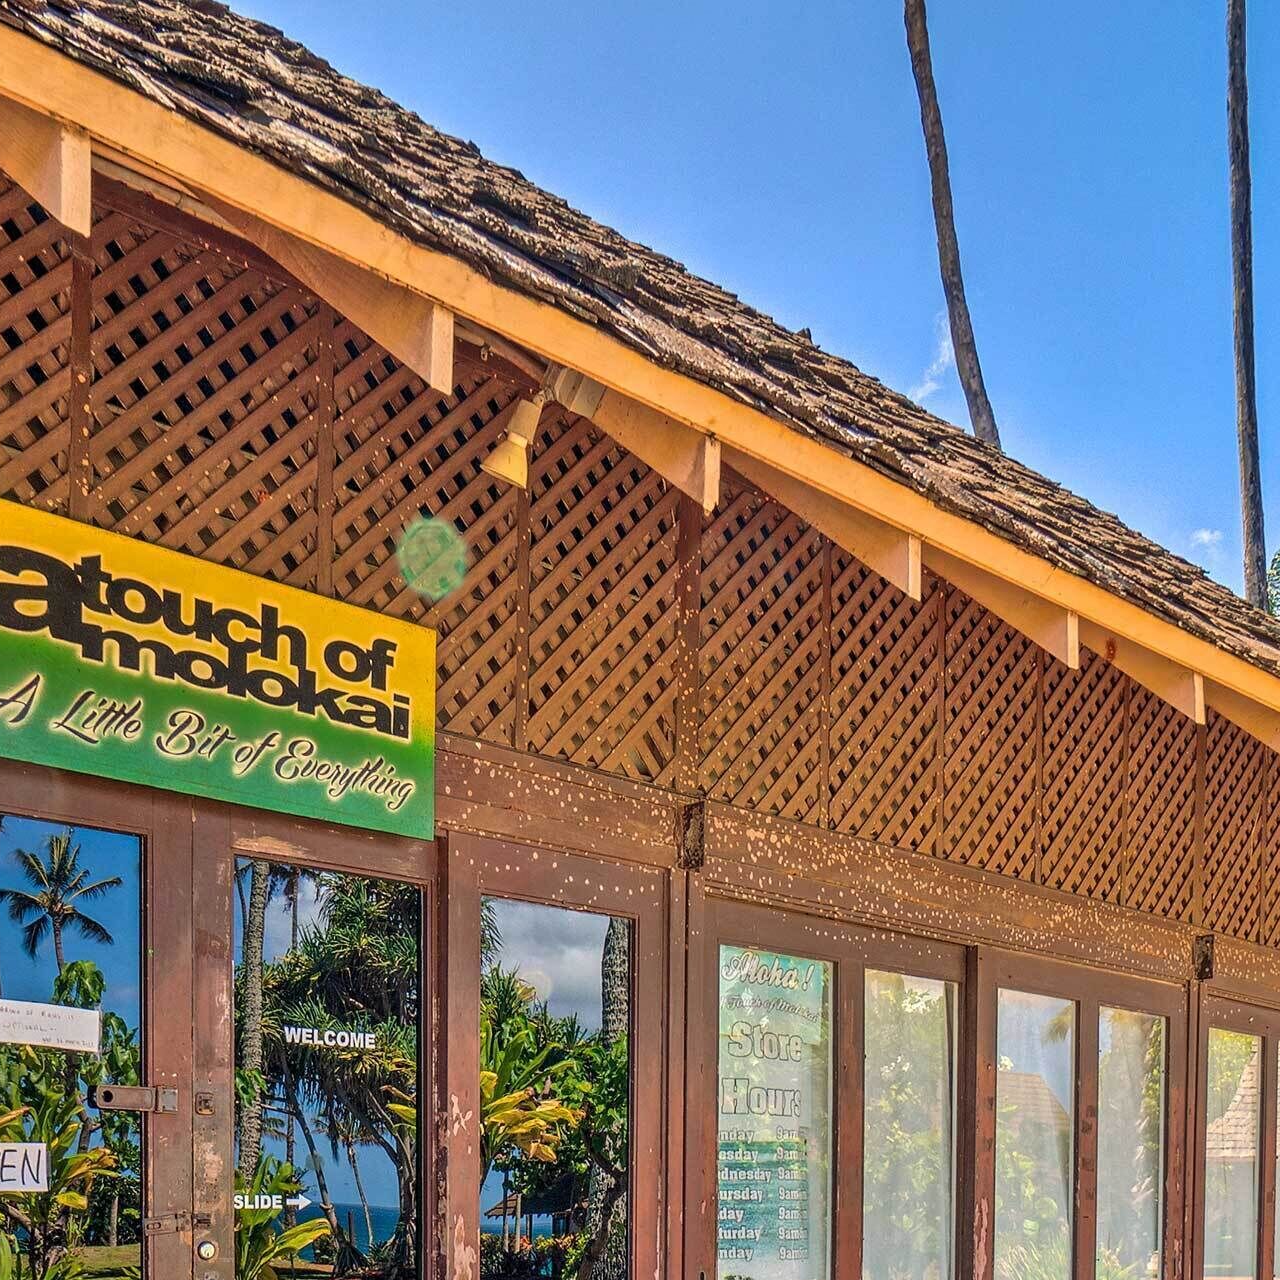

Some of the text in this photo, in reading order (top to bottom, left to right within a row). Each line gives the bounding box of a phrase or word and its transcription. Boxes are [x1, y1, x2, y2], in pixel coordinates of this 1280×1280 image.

[74, 553, 306, 666] touch
[324, 638, 397, 692] of
[80, 622, 410, 740] molokai
[53, 690, 143, 744] Little
[156, 710, 237, 758] Bit
[234, 732, 280, 776] of
[274, 739, 415, 811] Everything
[283, 1026, 376, 1049] WELCOME
[728, 1021, 804, 1062] Store
[720, 1128, 755, 1144] nday
[719, 1148, 759, 1163] esday
[719, 1167, 772, 1183] dnesday
[233, 1194, 283, 1210] SLIDE
[719, 1187, 763, 1203] ursday
[719, 1206, 745, 1222] day
[719, 1226, 762, 1242] turday
[720, 1246, 754, 1262] nday
